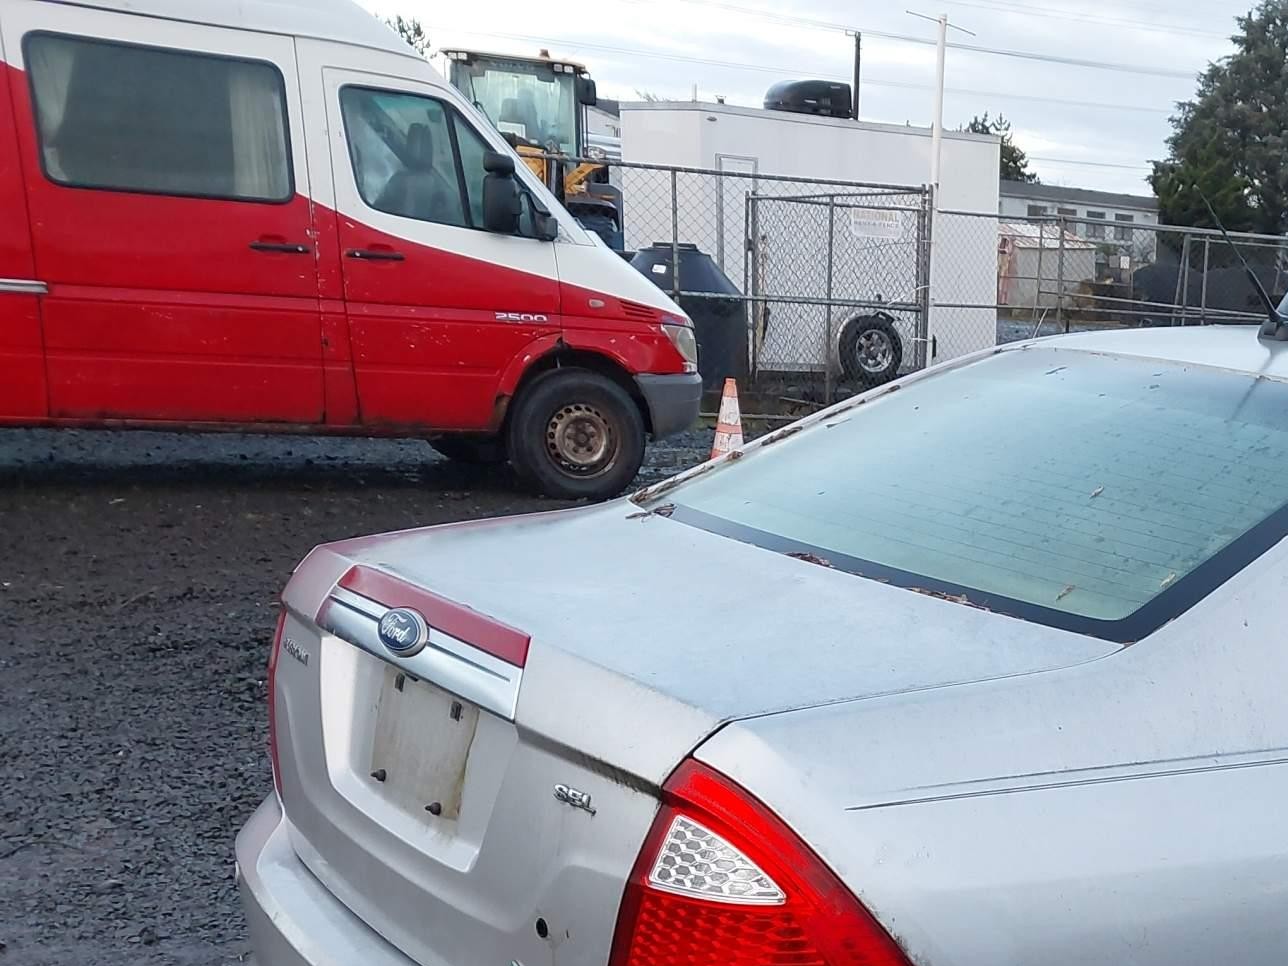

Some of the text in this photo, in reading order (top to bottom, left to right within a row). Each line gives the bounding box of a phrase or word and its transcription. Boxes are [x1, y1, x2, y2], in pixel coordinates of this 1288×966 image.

[495, 311, 548, 322] 2500
[381, 612, 410, 643] Ford
[553, 784, 597, 817] SEL
